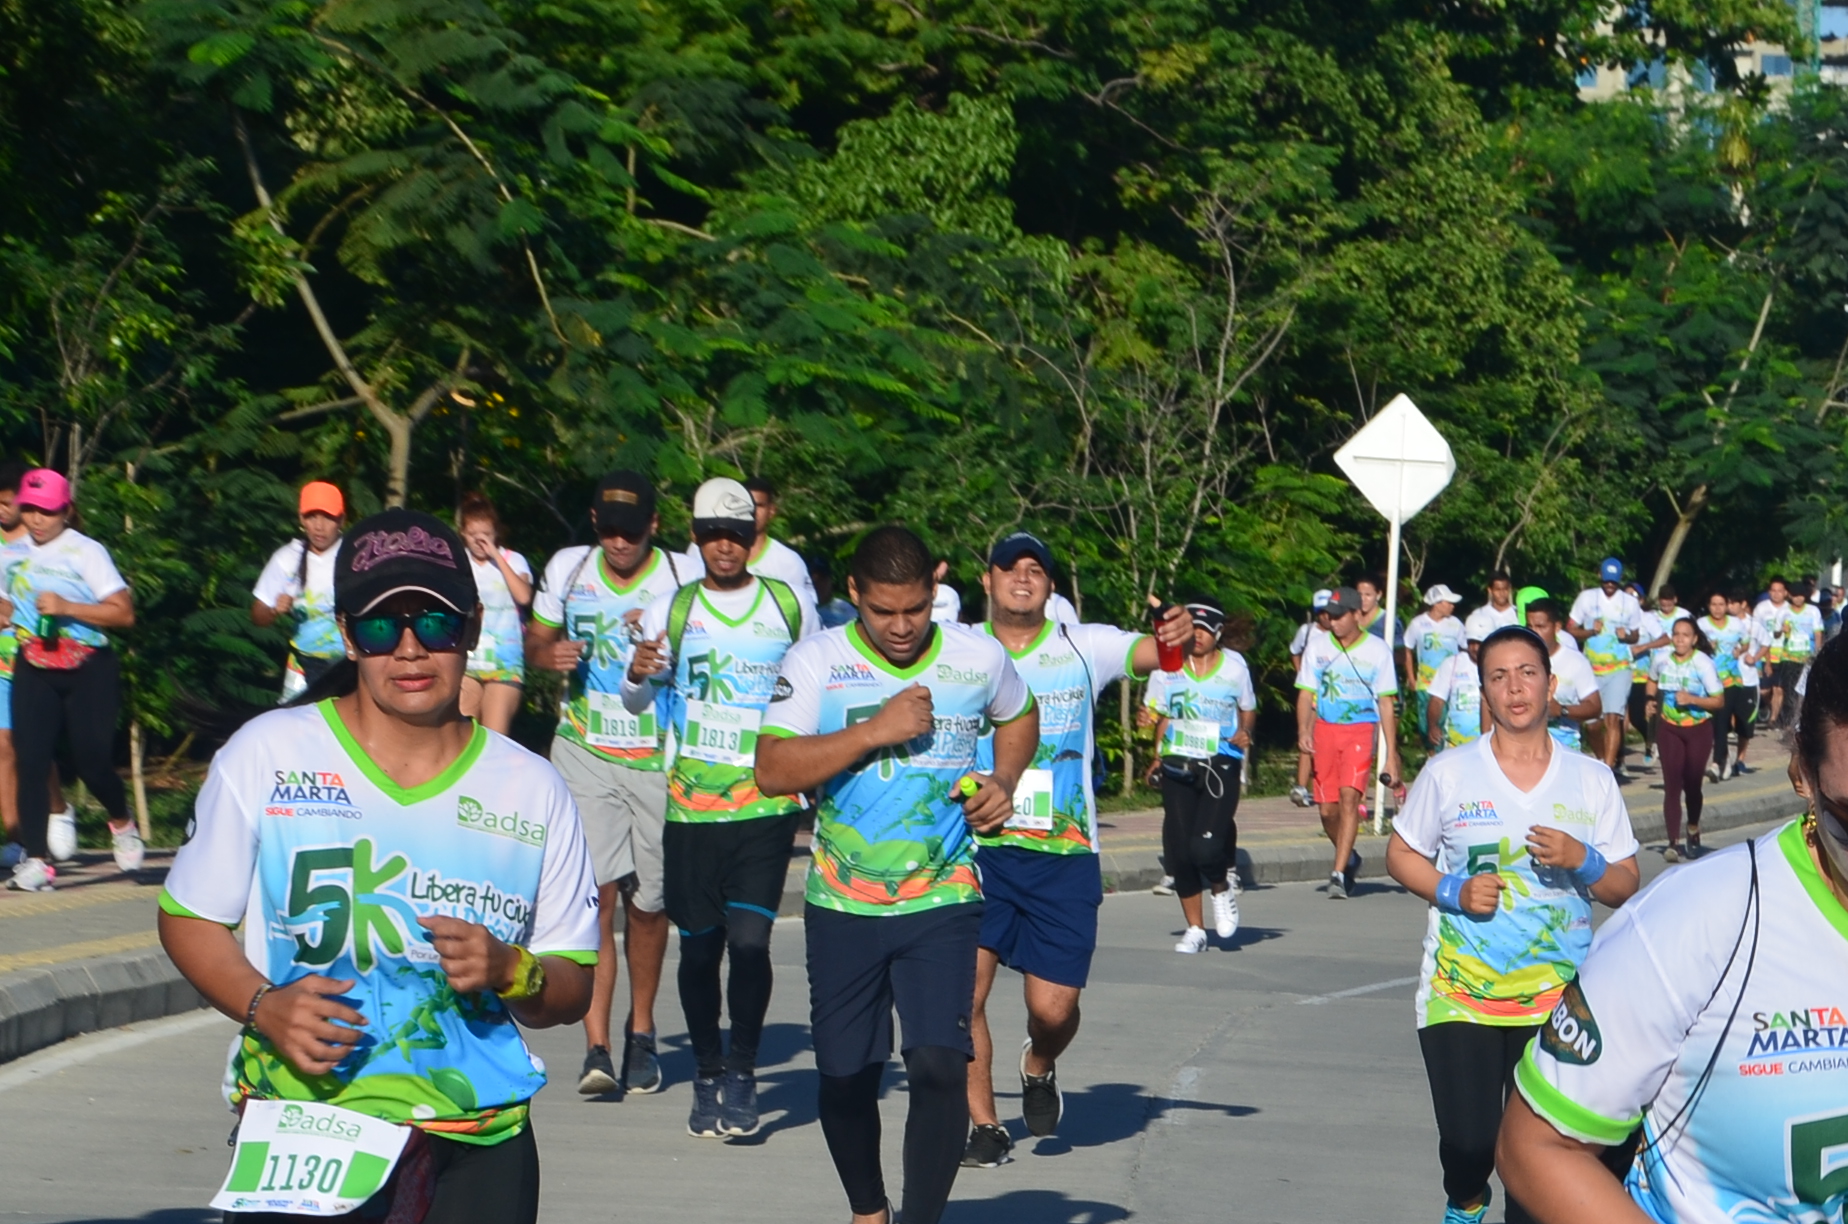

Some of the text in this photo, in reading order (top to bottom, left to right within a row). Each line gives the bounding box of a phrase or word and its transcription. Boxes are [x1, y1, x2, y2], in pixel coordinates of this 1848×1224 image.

[687, 648, 734, 704] 5K
[829, 671, 876, 683] MARTA
[830, 663, 870, 672] SANTA
[700, 727, 738, 751] 1813
[275, 771, 345, 787] SANTA
[270, 785, 351, 804] MARTA
[265, 807, 363, 820] SIGUE CAMBIANDO
[1457, 809, 1498, 821] MARTA
[1459, 801, 1494, 812] SANTA
[410, 872, 477, 907] Libera
[479, 884, 501, 913] tu
[288, 838, 408, 973] 5K
[1552, 995, 1597, 1061] BON
[1752, 1006, 1848, 1032] SANTA
[1738, 1062, 1784, 1077] SIGUE
[260, 1153, 343, 1194] 1130
